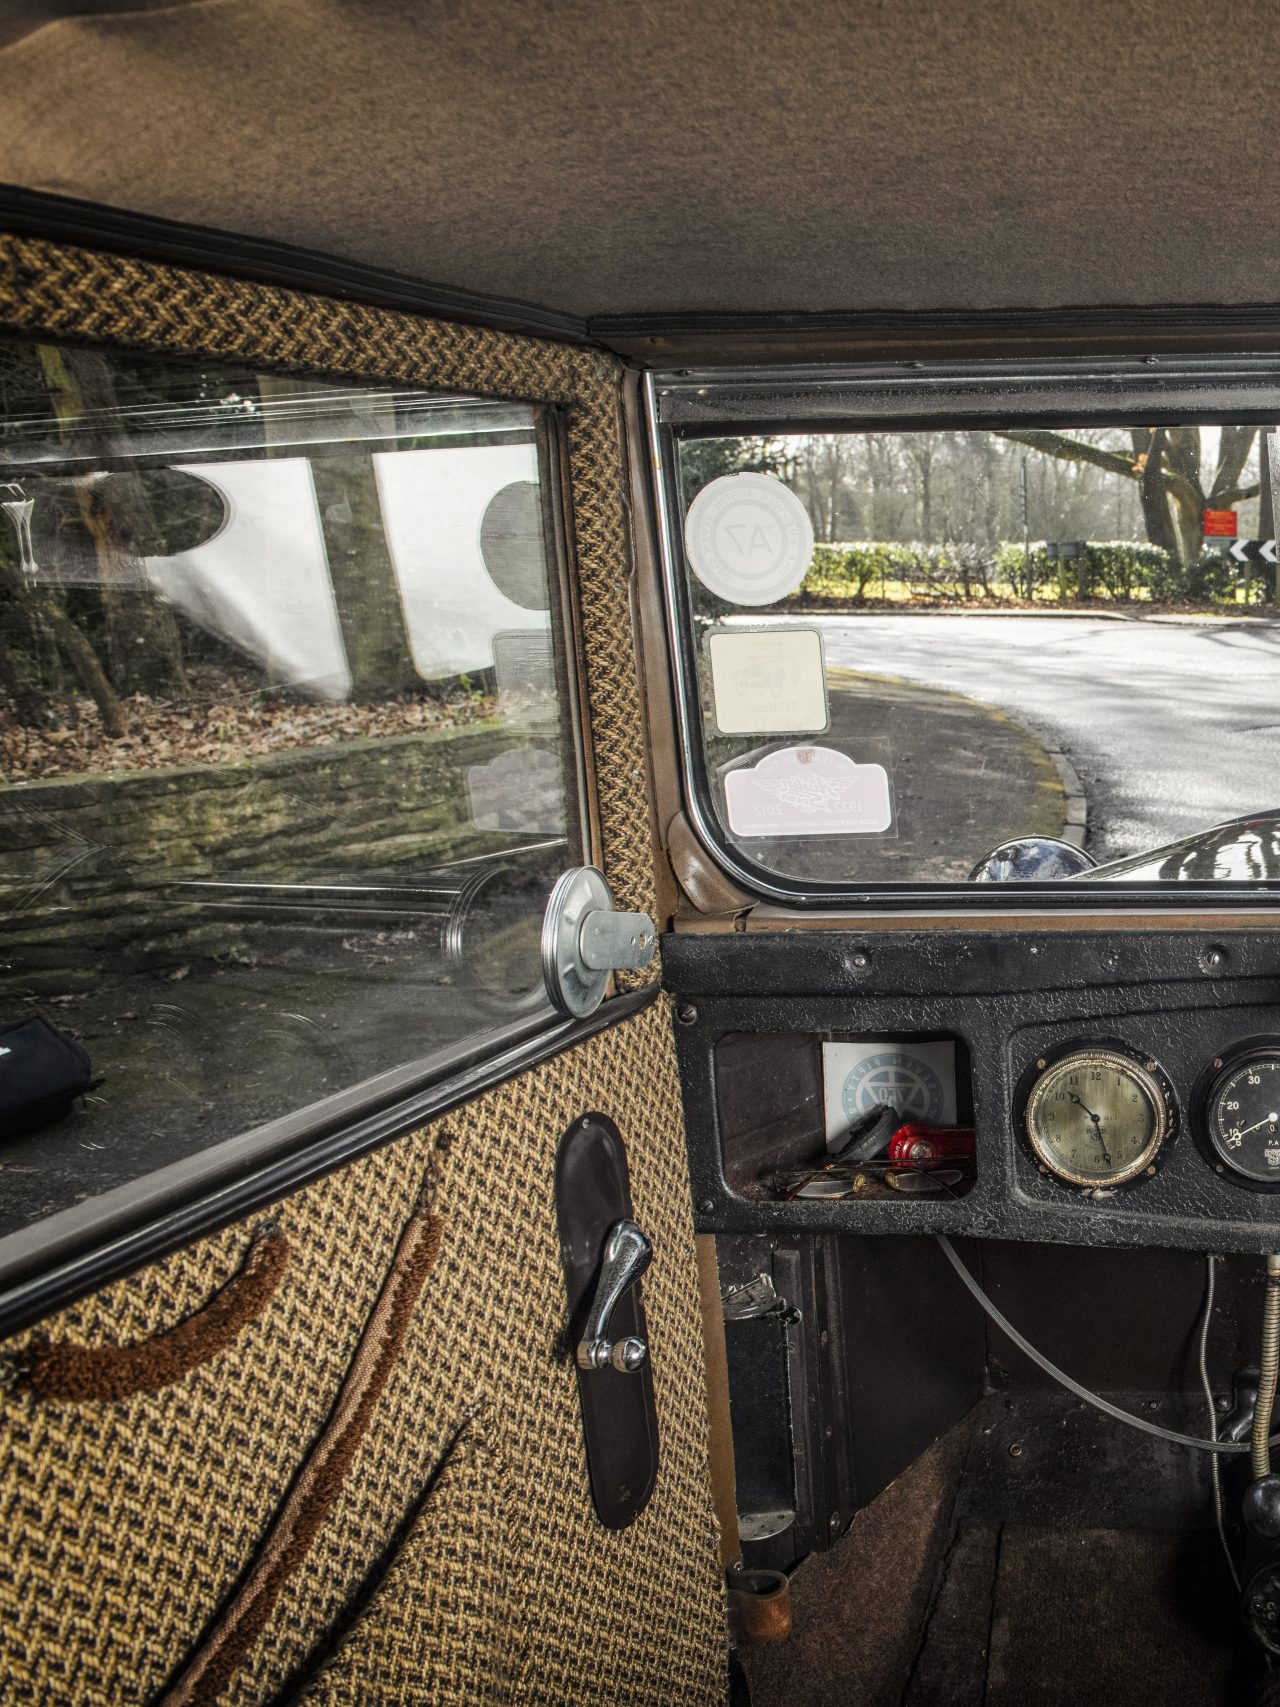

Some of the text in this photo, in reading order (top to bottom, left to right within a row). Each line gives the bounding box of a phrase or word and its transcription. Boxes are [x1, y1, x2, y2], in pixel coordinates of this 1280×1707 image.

[1091, 1072, 1101, 1080] 12
[1248, 1076, 1260, 1084] 30
[1070, 1077, 1079, 1085] 11
[1055, 1093, 1065, 1101] 10
[1132, 1094, 1138, 1102] 2
[1226, 1102, 1239, 1110] 20
[1056, 1134, 1062, 1142] 8
[1131, 1136, 1138, 1144] 4
[1072, 1150, 1078, 1158] 7
